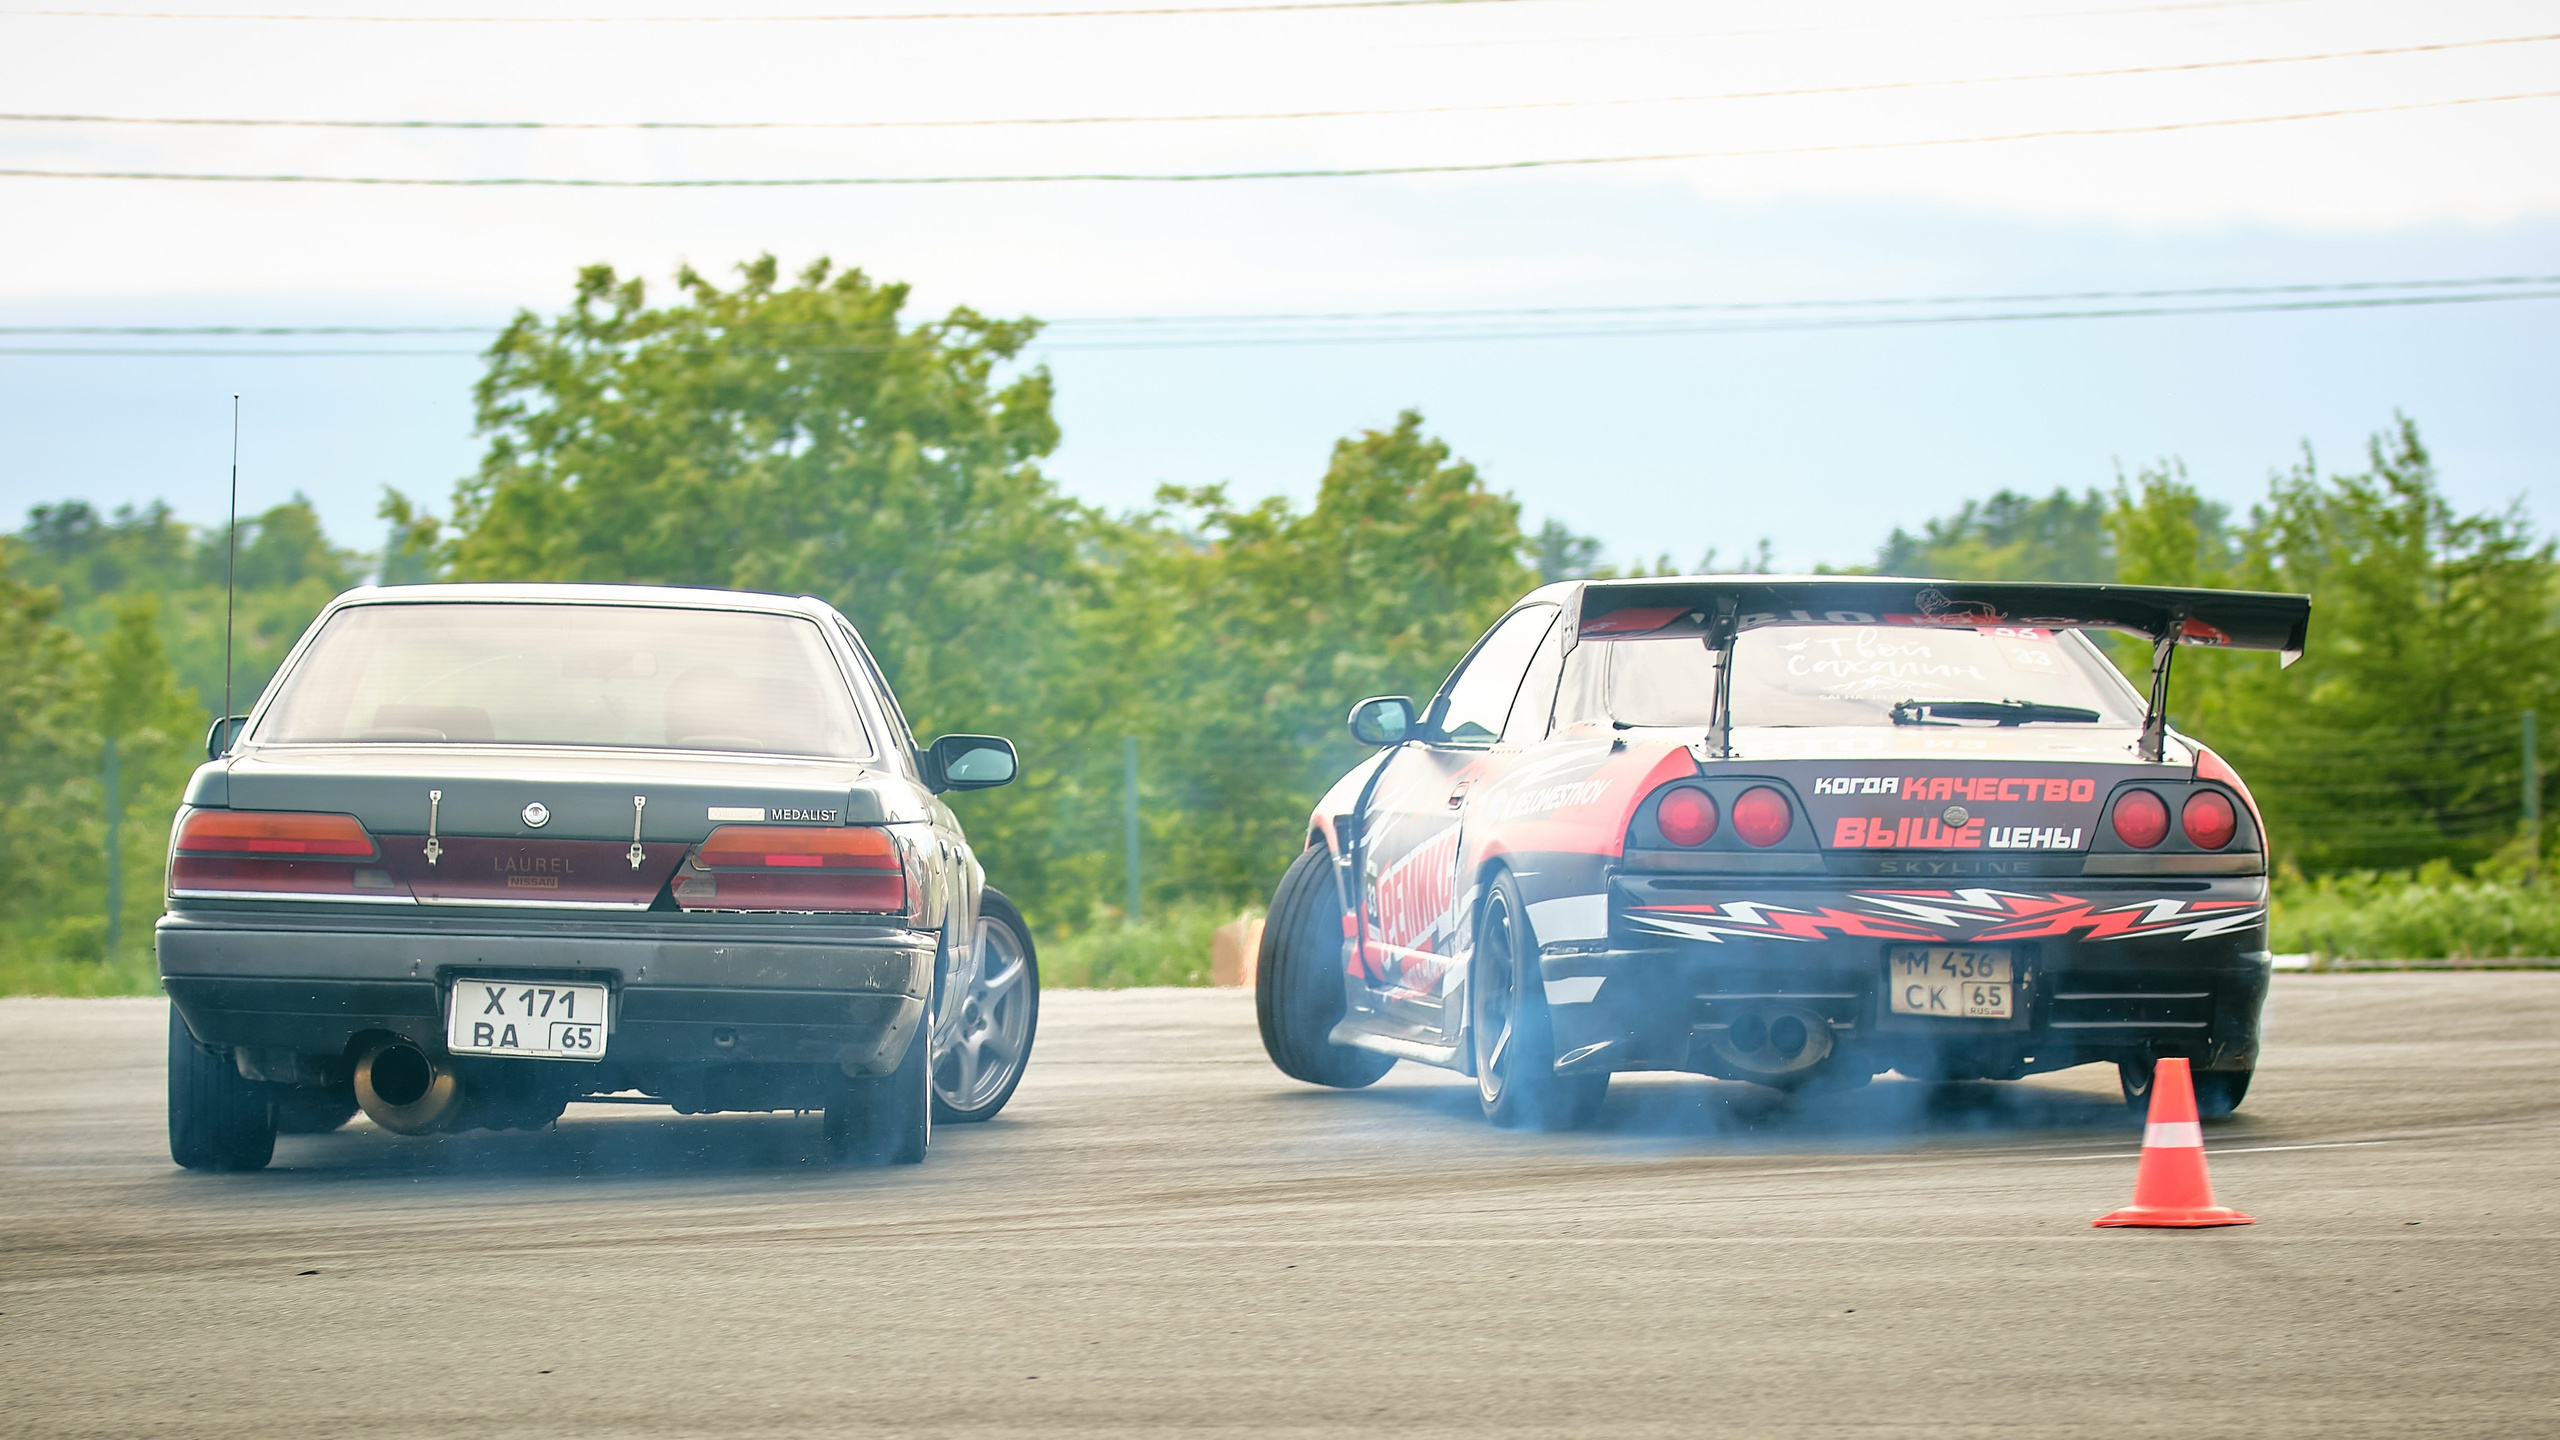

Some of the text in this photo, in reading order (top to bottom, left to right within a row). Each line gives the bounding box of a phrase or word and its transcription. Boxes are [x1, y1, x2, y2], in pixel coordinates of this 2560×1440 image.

[2010, 647, 2054, 667] 33
[1813, 777, 2096, 802] КОГДА КАЧЕСТВО
[771, 807, 838, 822] MEDALIST
[1832, 817, 2082, 849] ВЫШЕ ЦЕНЫ
[494, 856, 574, 874] LAUREL
[1880, 860, 2031, 874] SKYLINE
[509, 876, 556, 888] NISSAN
[1907, 951, 1995, 978] М 436
[483, 986, 576, 1019] Х 171
[1905, 984, 1947, 1010] СК
[1973, 985, 2002, 1006] 65
[1970, 1007, 1991, 1016] RUS
[473, 1022, 519, 1048] ВА
[561, 1027, 593, 1049] 65
